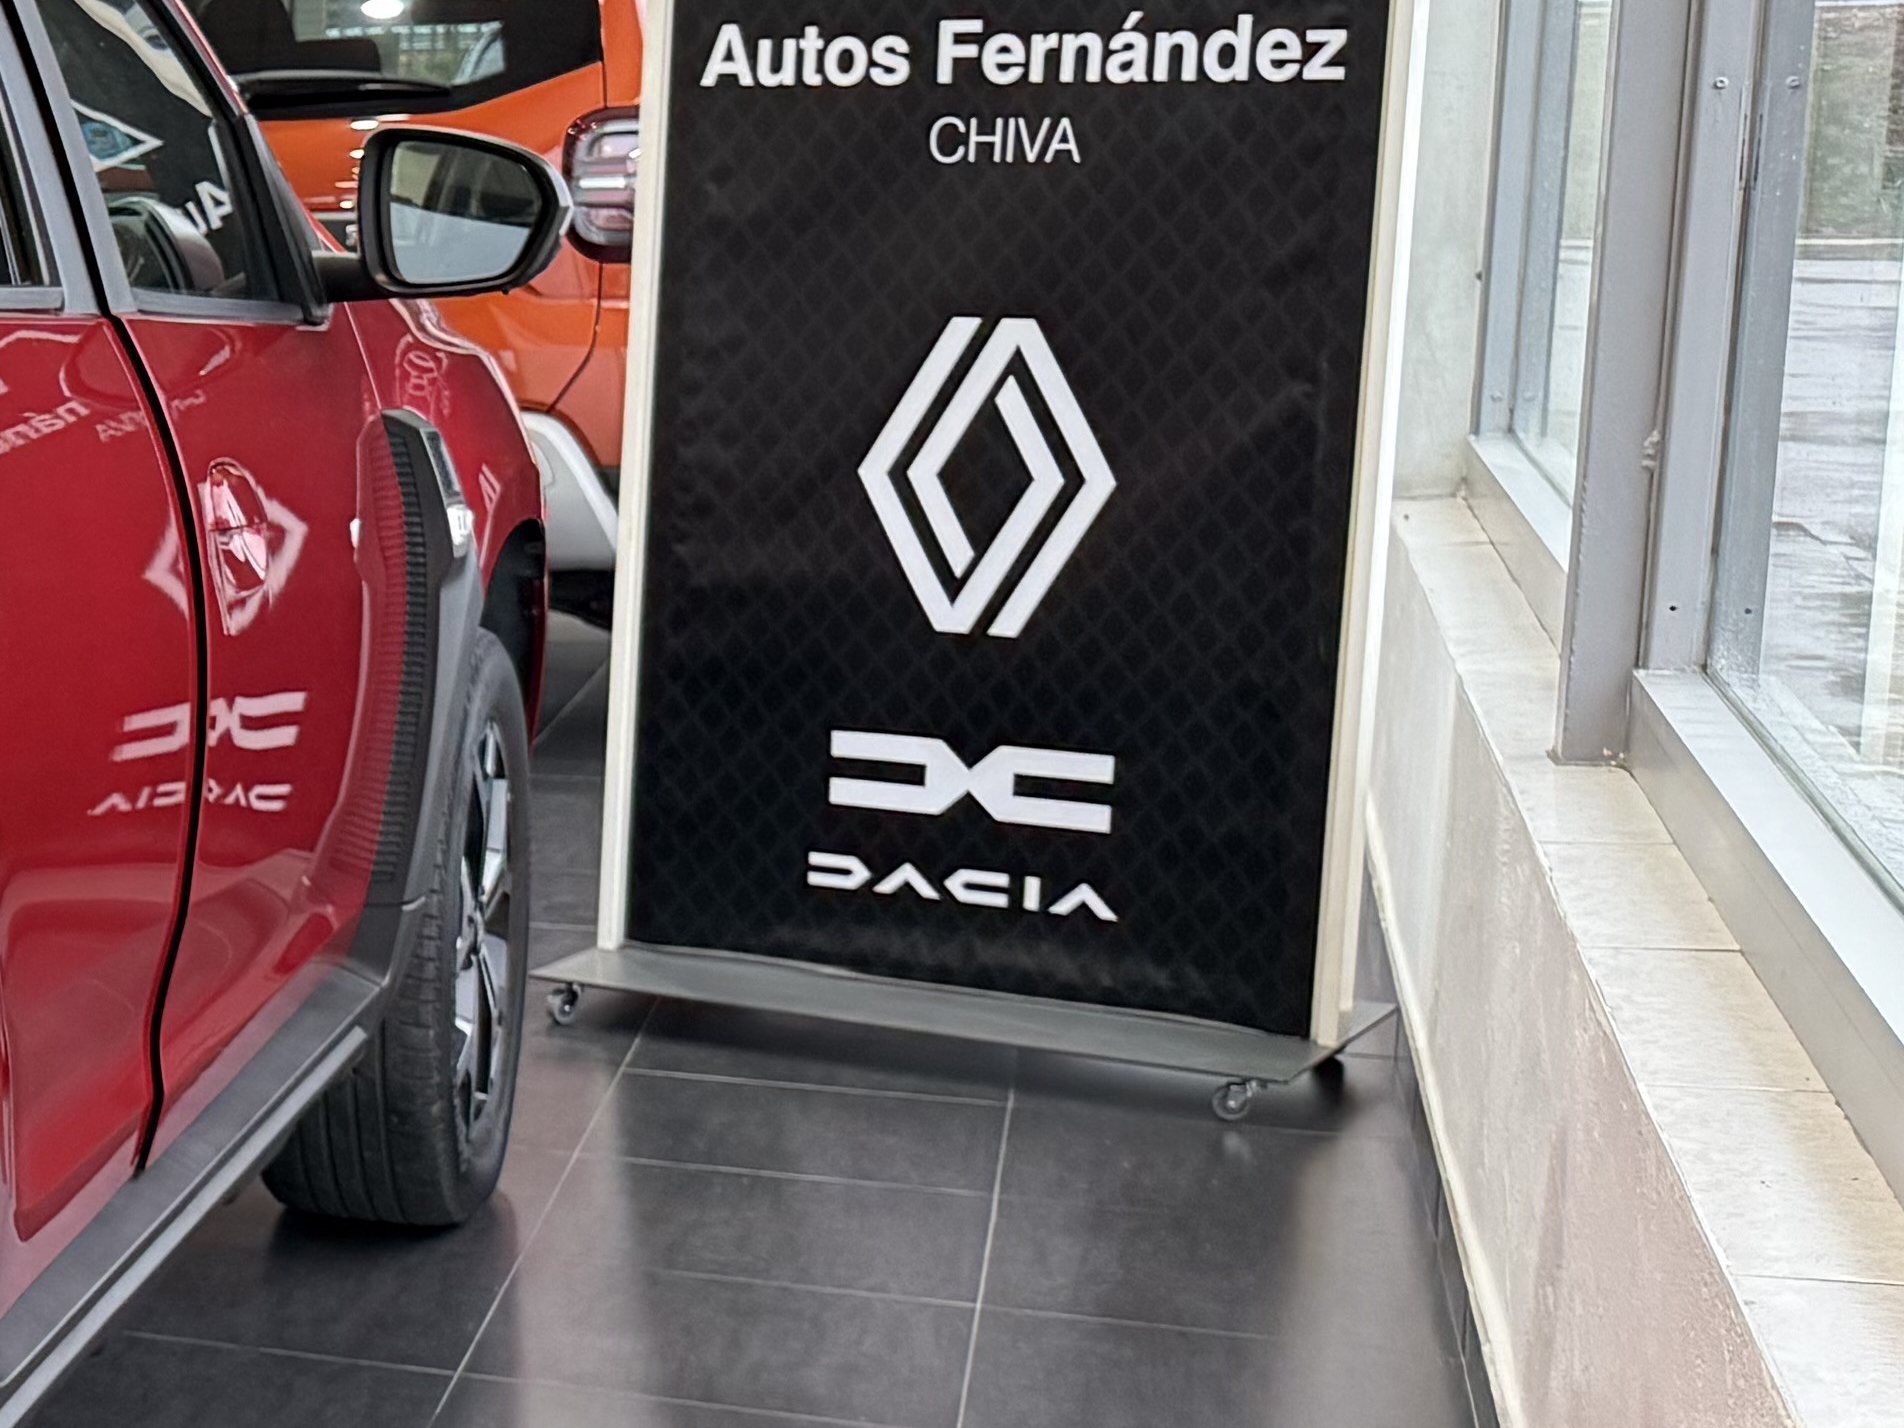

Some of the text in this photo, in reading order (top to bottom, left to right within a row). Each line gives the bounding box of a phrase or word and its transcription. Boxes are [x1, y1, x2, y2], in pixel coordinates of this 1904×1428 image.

[699, 10, 1348, 88] Autos Fernández
[927, 115, 1082, 165] CHIVA
[806, 850, 1119, 924] DACIA
